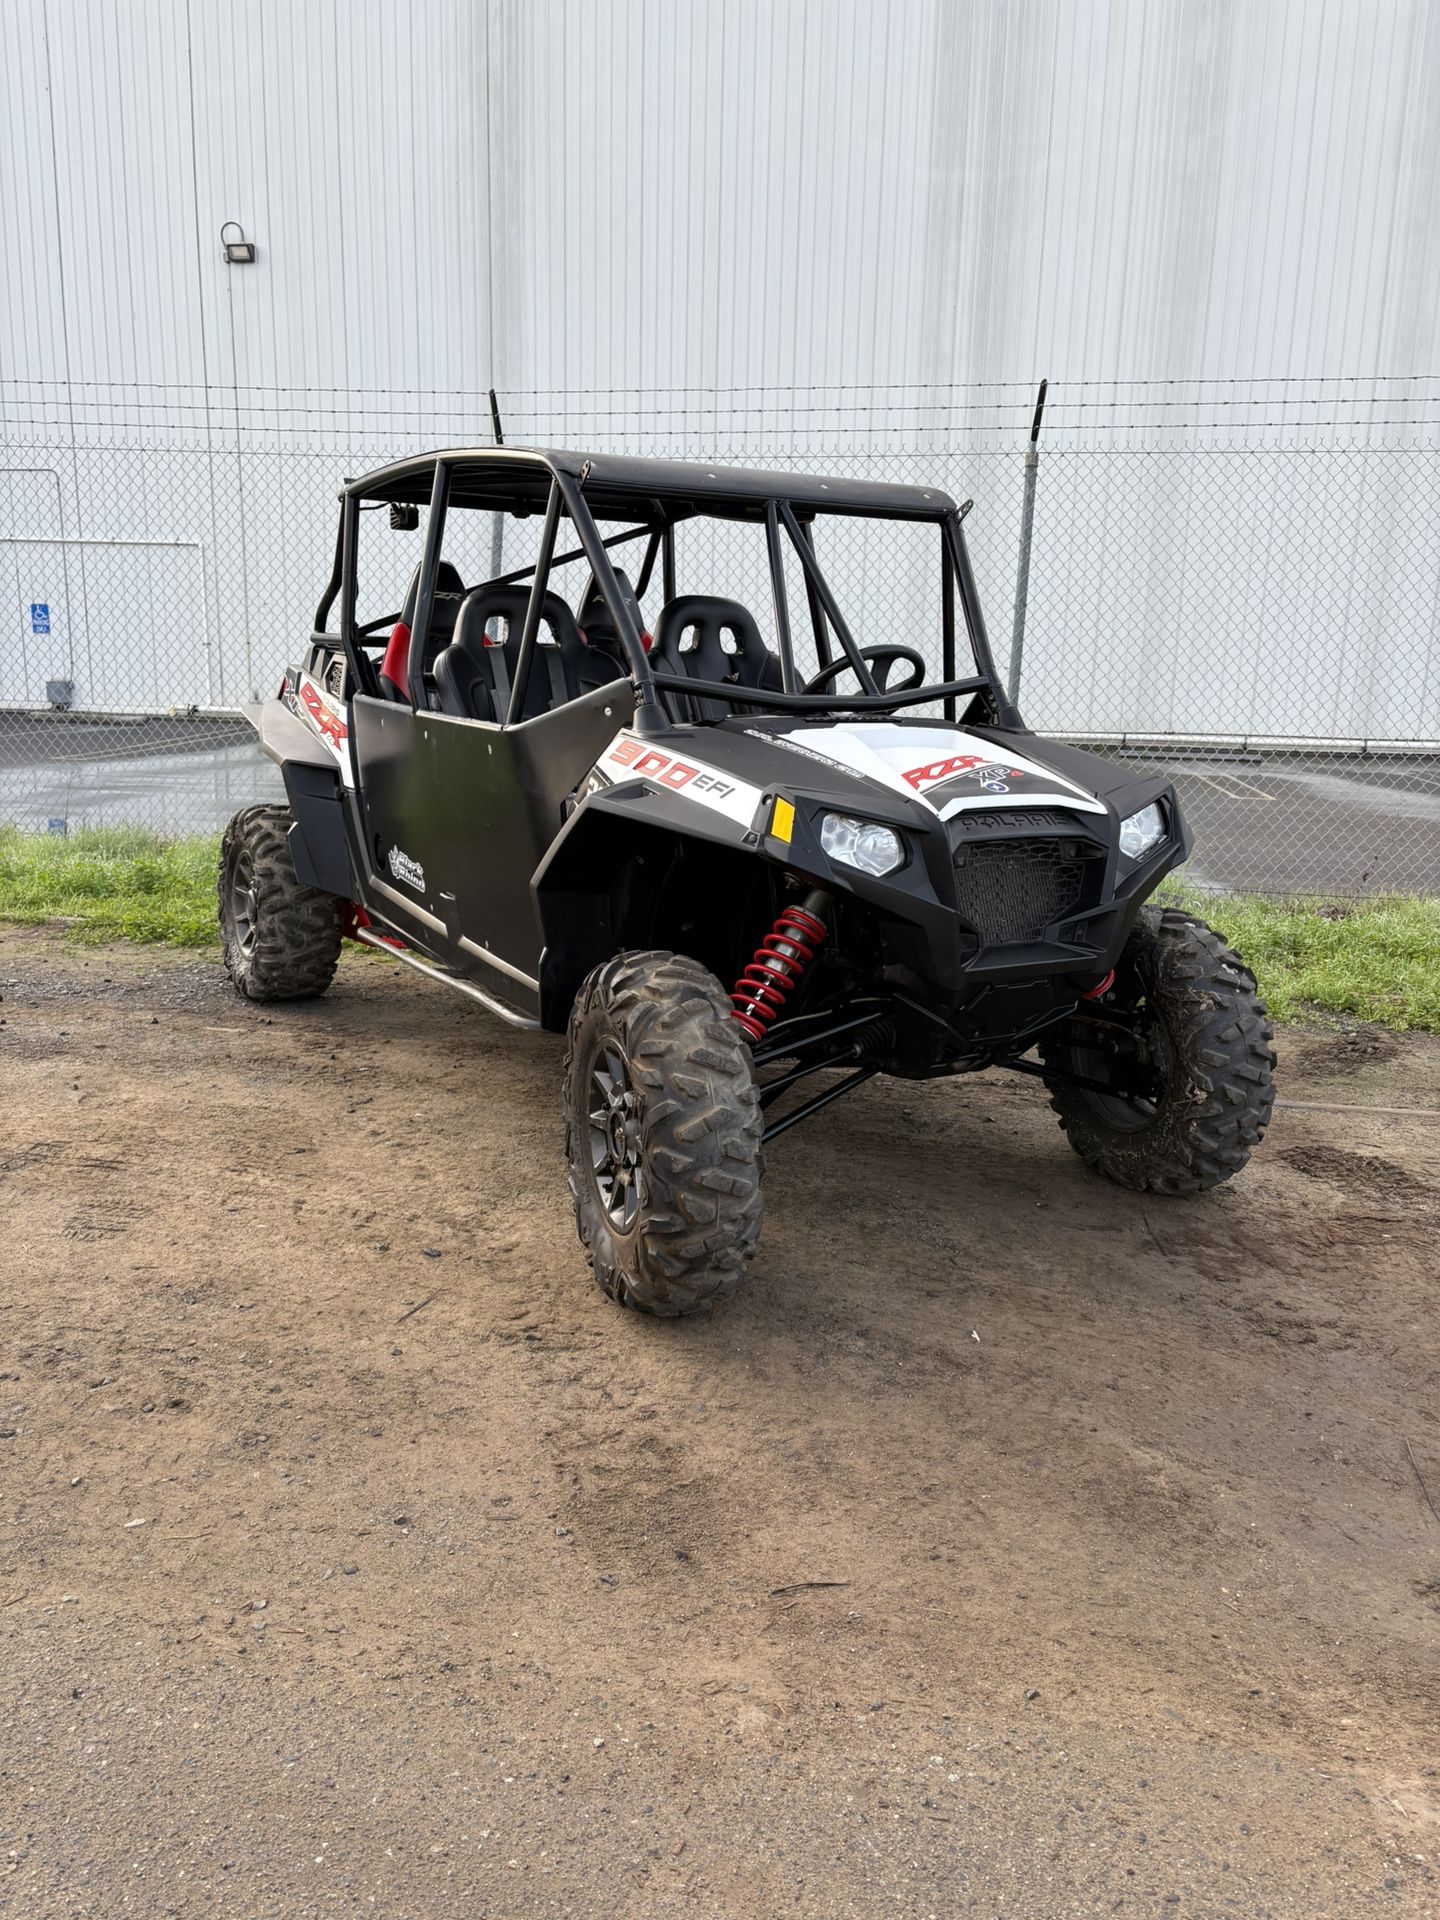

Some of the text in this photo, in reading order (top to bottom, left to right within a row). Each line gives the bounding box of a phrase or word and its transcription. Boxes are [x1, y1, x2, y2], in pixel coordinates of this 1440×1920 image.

[609, 739, 701, 790] 900
[692, 774, 736, 799] EFI
[900, 755, 983, 790] RZR
[957, 811, 1074, 831] POLARIS
